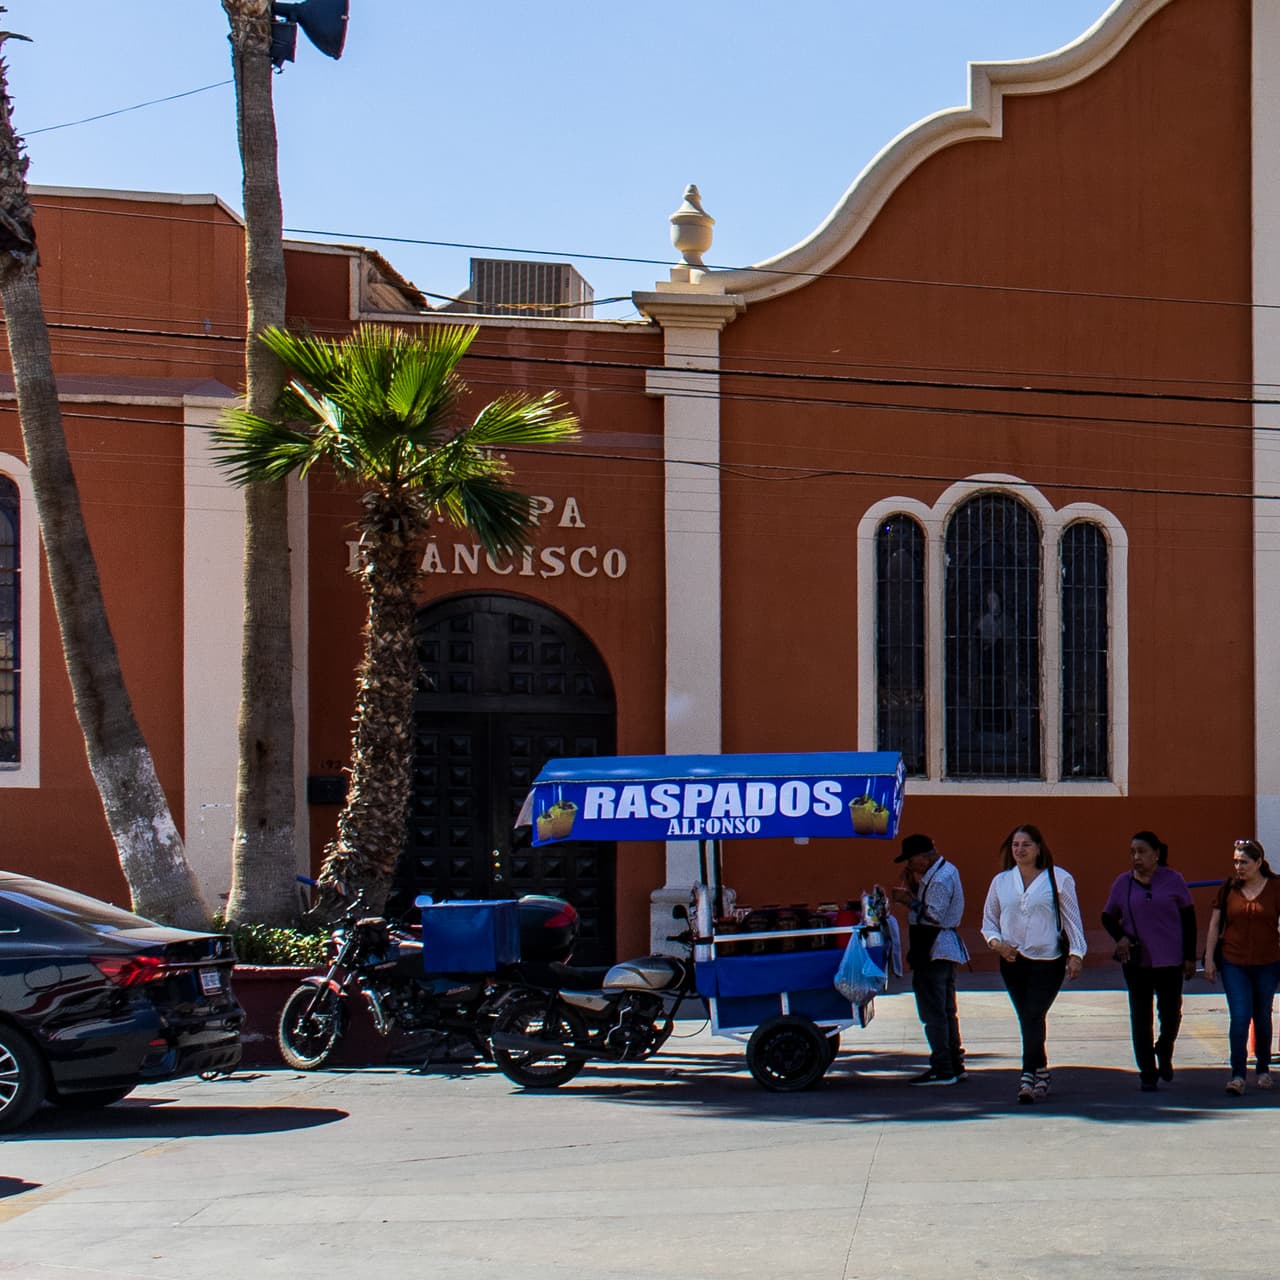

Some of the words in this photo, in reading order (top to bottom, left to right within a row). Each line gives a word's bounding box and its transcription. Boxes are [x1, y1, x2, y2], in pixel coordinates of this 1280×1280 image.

[345, 540, 628, 579] FANCISCO
[583, 780, 843, 819] RASPADOS
[667, 816, 761, 836] ALFONSO
